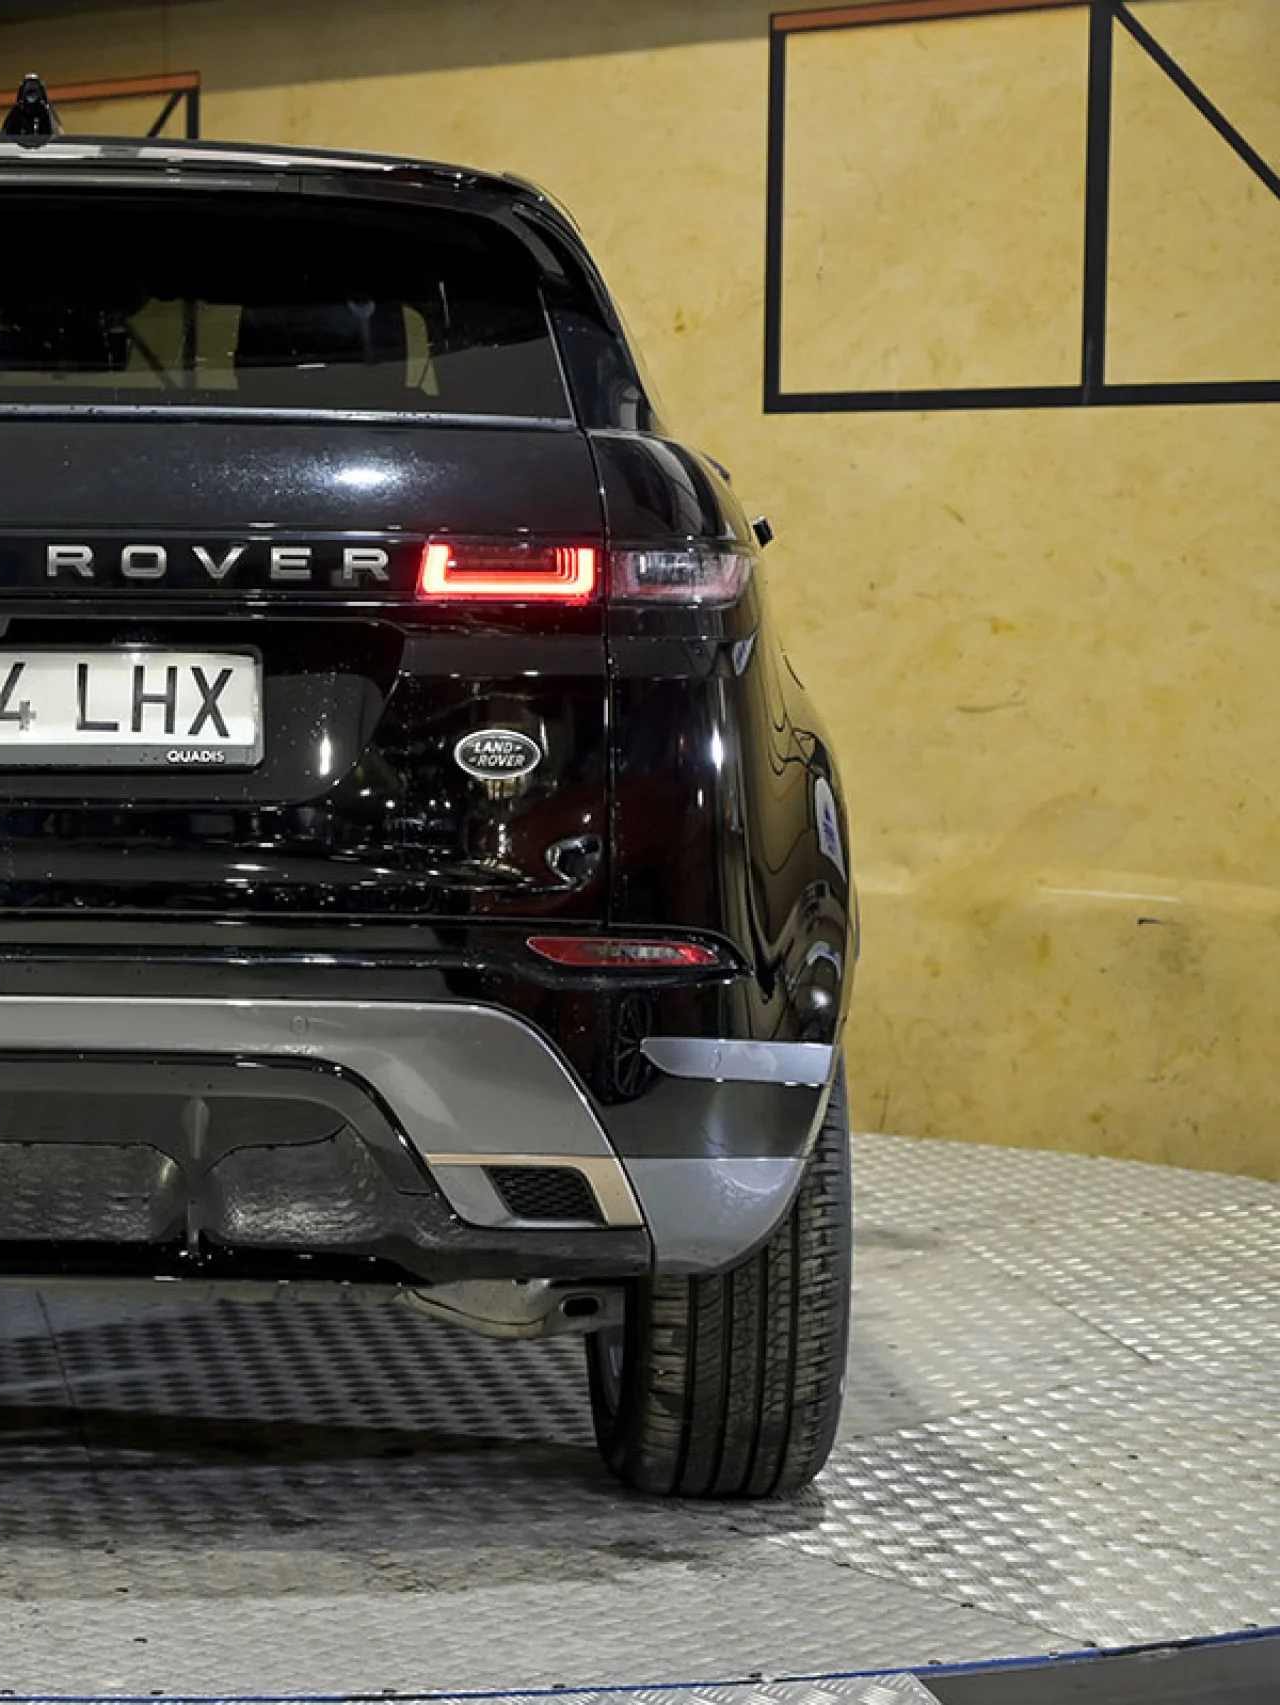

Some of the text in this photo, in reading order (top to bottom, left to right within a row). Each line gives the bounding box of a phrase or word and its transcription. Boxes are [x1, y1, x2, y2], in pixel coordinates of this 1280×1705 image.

[47, 544, 391, 579] ROVER
[75, 663, 234, 738] LHX
[166, 748, 225, 763] QUADIS
